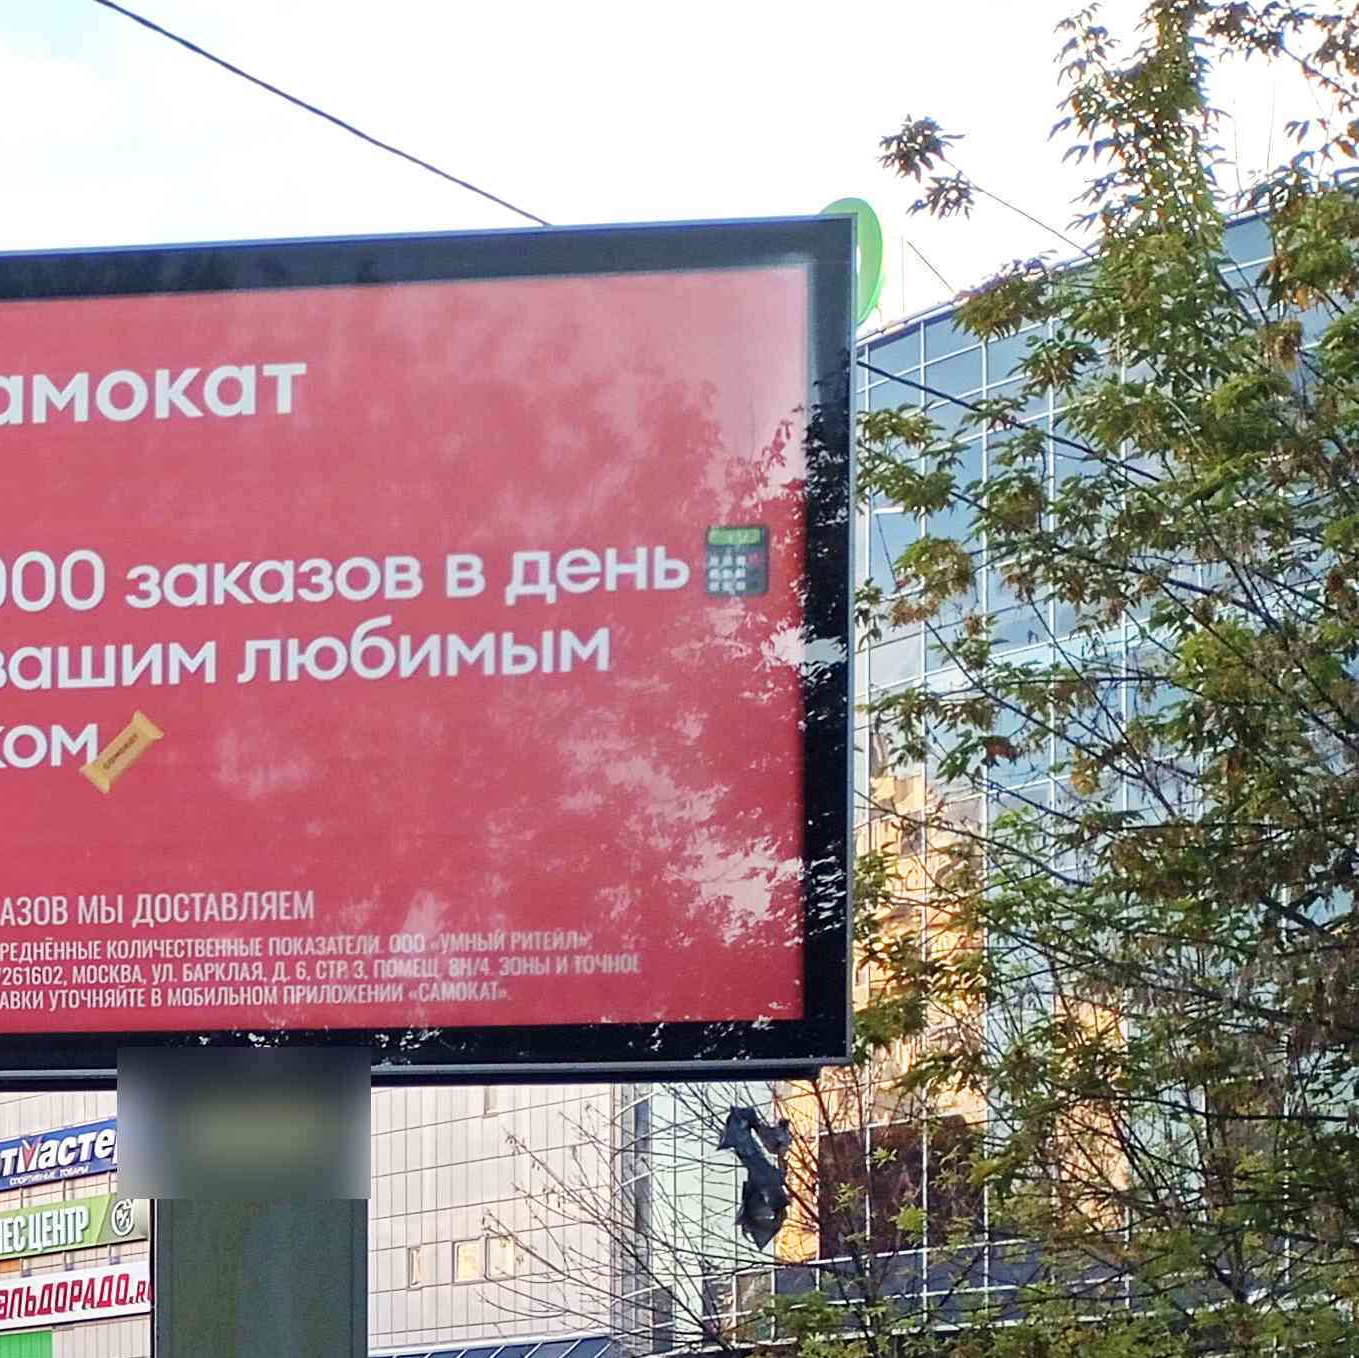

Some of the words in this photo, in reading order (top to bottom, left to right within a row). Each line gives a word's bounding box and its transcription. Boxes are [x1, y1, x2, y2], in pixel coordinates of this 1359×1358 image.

[124, 555, 424, 609] заказов
[445, 553, 486, 599] в
[504, 545, 691, 606] день
[236, 614, 611, 684] любимым
[77, 894, 124, 926] МЫ
[131, 890, 315, 927] ДОСТАВЛЯЕМ
[106, 937, 262, 960] КОЛИЧЕСТВЕННЫЕ
[389, 933, 426, 953] ООО
[71, 963, 147, 985] МОСКВА,
[151, 963, 179, 985] УЛ.
[272, 961, 291, 983] Д.
[499, 955, 550, 976] ЗОНЫ
[555, 955, 568, 974] И
[573, 953, 642, 975] ТОЧНОЕ
[49, 985, 146, 1012] УТОЧНЯЙТЕ
[151, 988, 162, 1007] В
[167, 985, 278, 1007] МОБИЛЬНОМ
[283, 983, 403, 1005] ПРИЛОЖЕНИИ
[28, 1205, 91, 1253] ЦЕНТР
